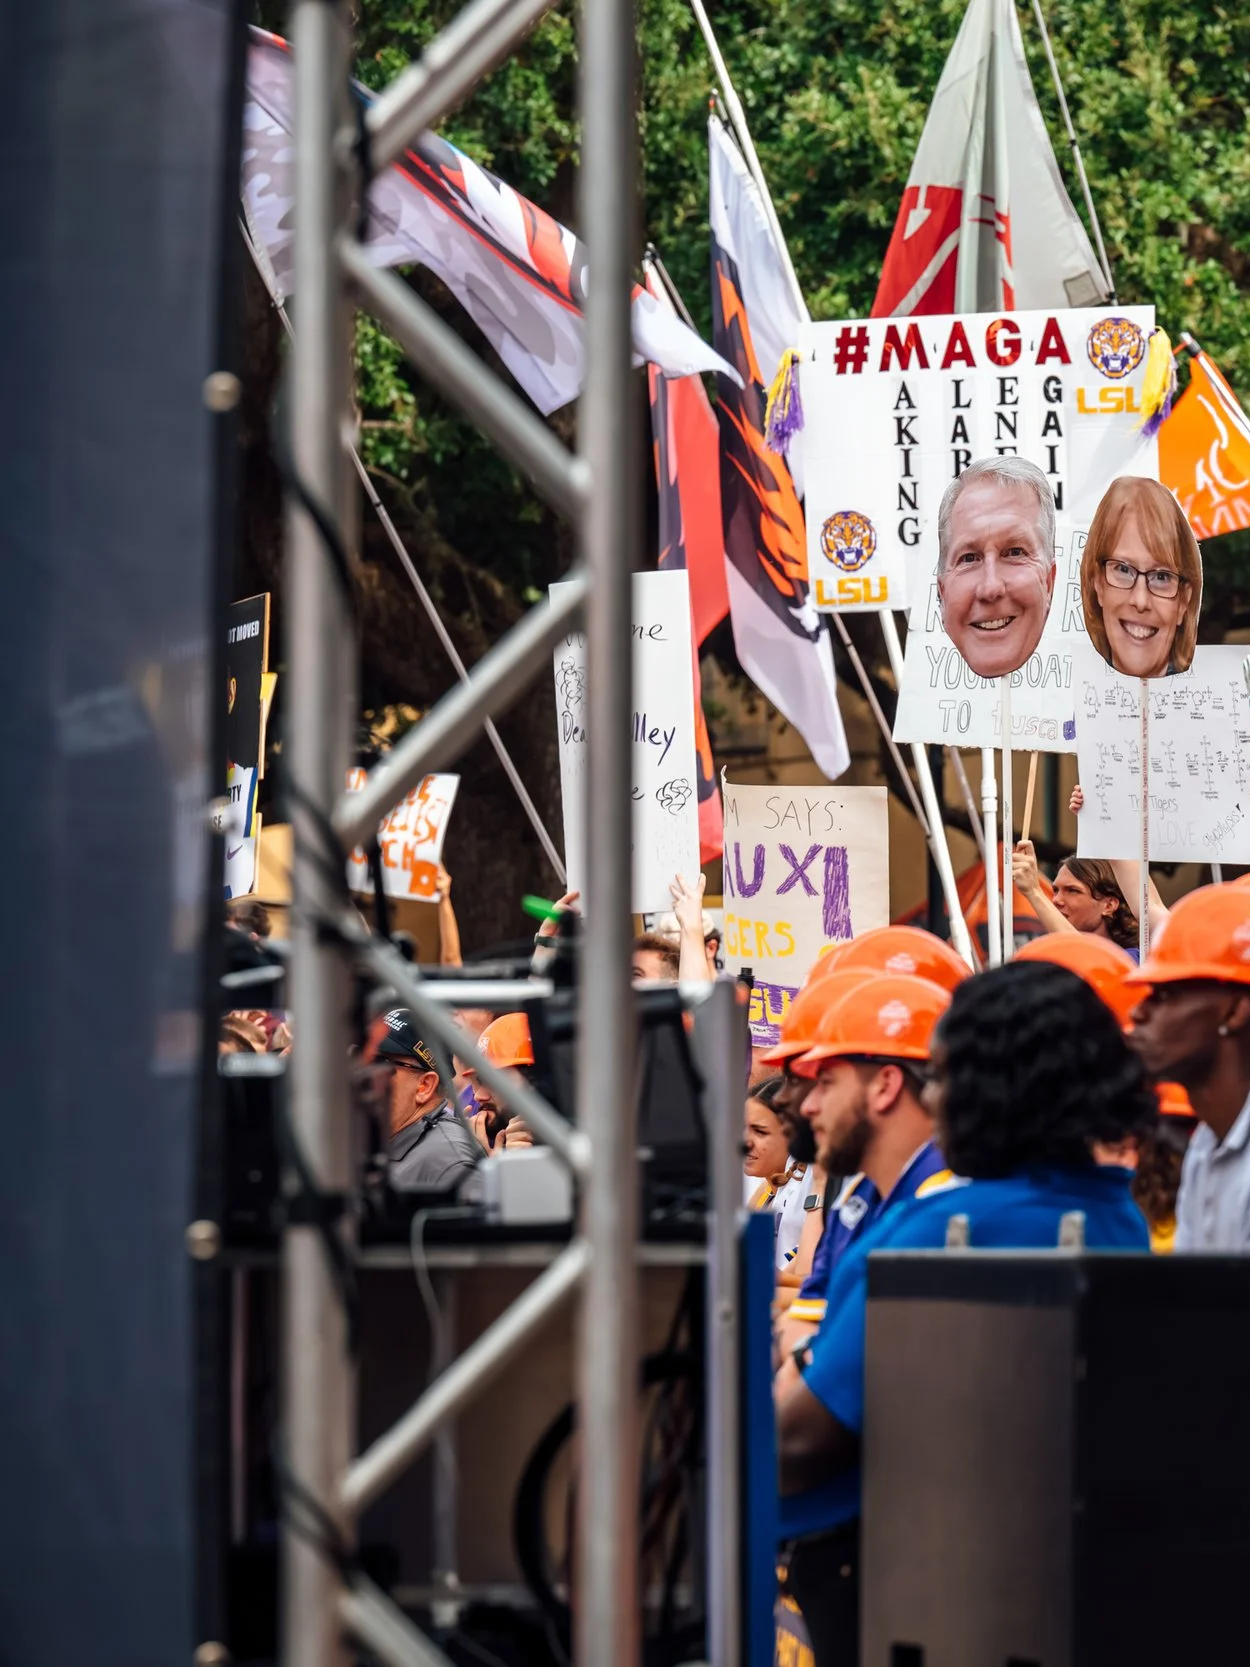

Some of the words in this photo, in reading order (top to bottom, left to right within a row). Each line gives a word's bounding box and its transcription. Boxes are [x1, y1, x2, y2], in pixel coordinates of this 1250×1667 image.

[833, 316, 1072, 376] #MAGA
[814, 575, 889, 607] LSU
[236, 619, 260, 642] MOVED
[938, 699, 972, 734] TO
[1149, 794, 1179, 820] Tigers
[1156, 819, 1198, 848] LOVE
